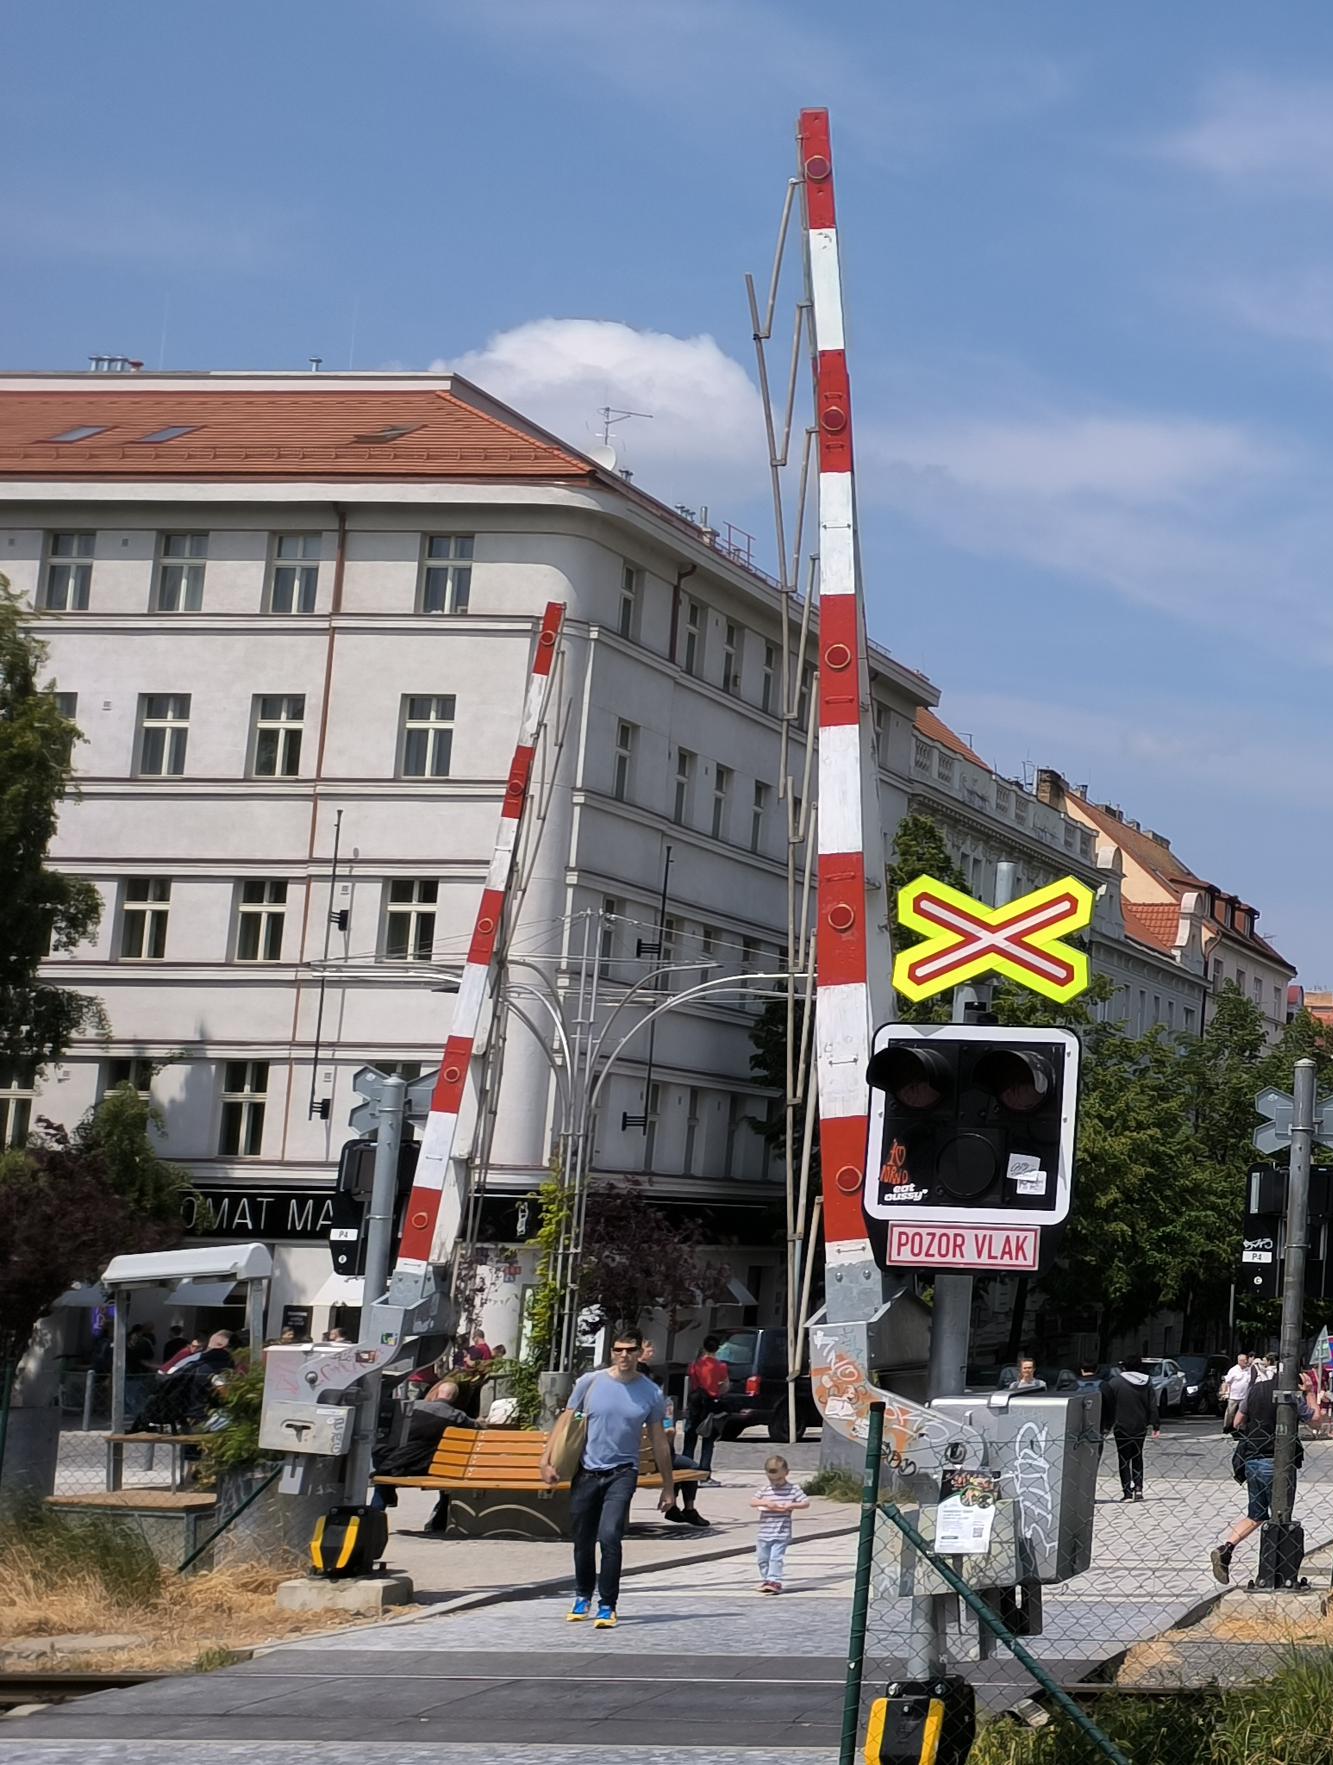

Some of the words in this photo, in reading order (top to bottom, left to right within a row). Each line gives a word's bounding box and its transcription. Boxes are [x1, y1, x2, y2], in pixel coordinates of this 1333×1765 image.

[896, 1231, 966, 1259] POZOR
[974, 1233, 1028, 1262] VLAK
[1252, 1252, 1263, 1261] P4
